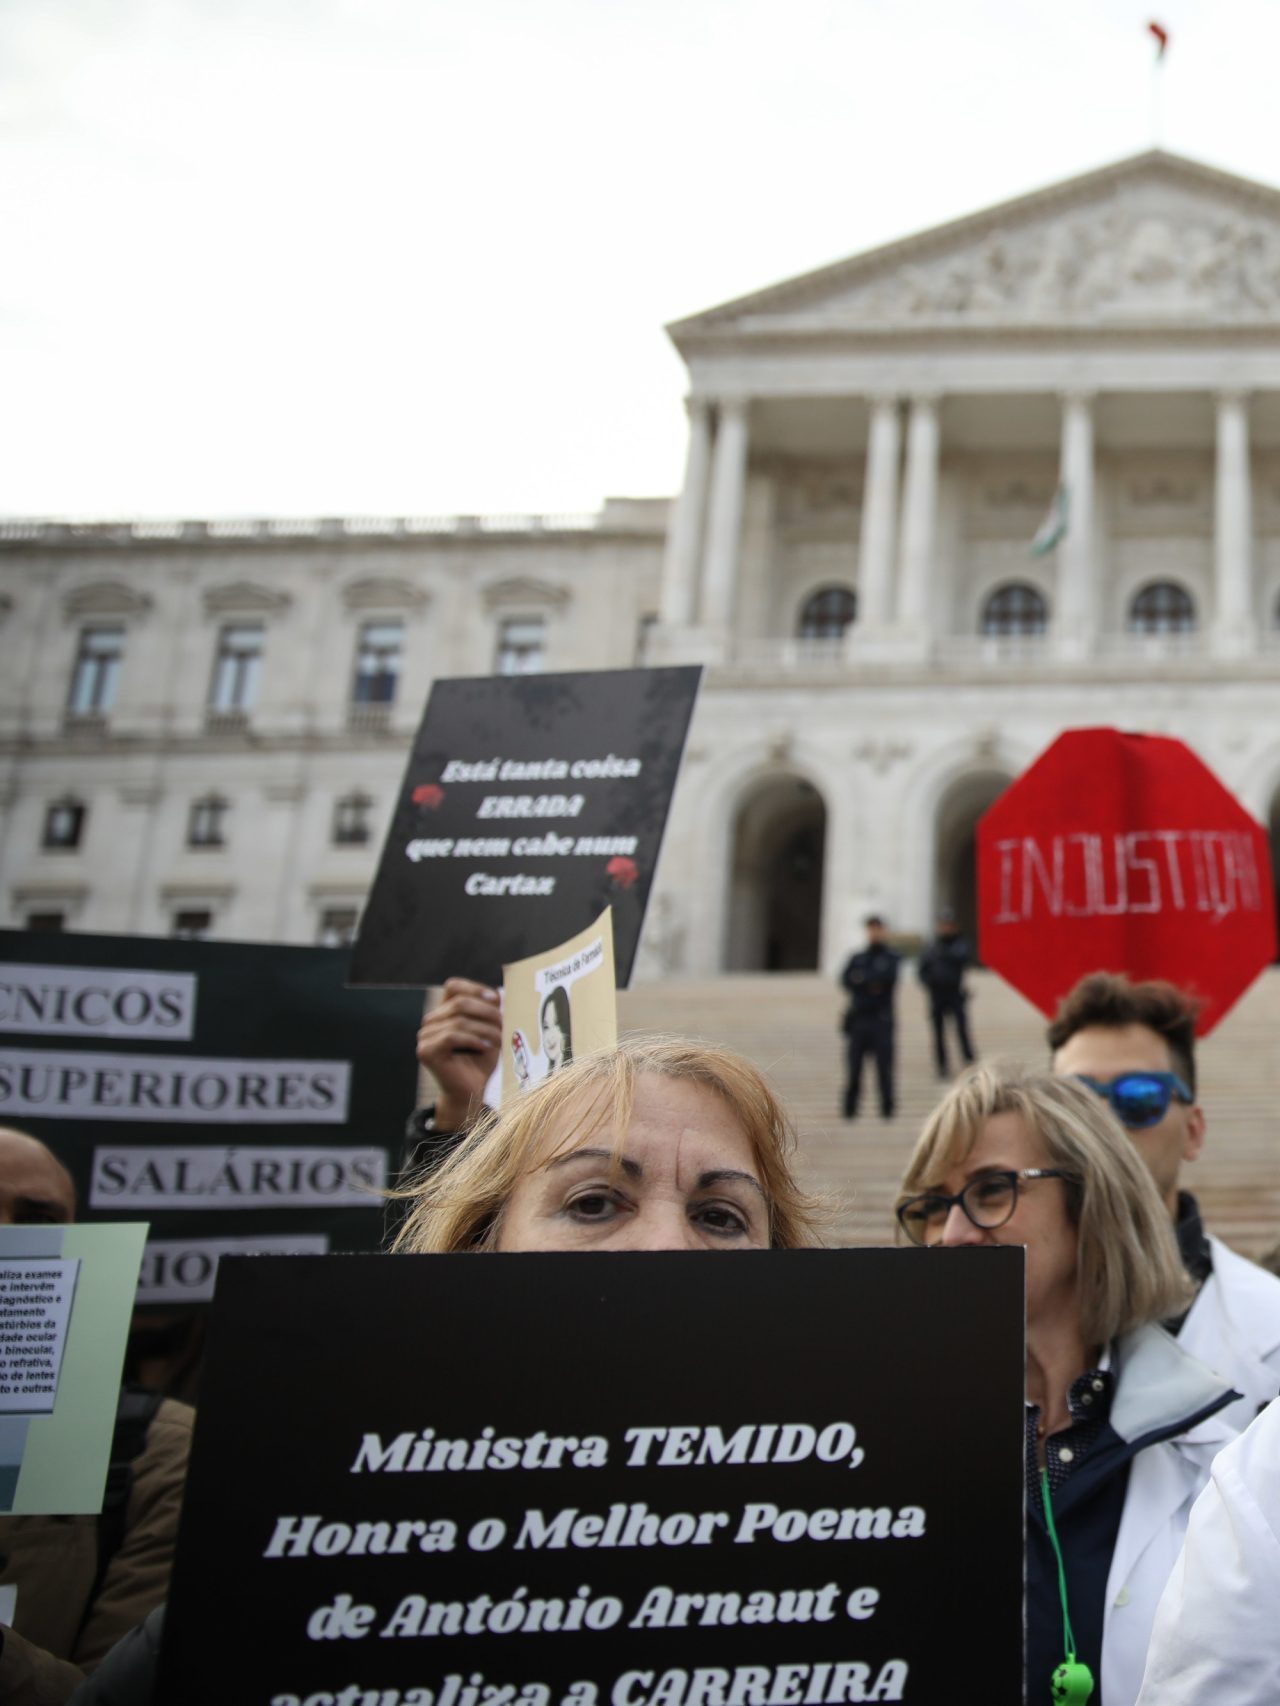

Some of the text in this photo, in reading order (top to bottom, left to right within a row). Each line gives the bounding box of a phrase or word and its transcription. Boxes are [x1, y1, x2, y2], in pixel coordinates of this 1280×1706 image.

[441, 754, 642, 783] Está tanta coisa
[476, 794, 586, 819] ERRADA
[406, 831, 638, 861] que nem cabe num
[100, 1147, 376, 1197] SALÁRIOS
[351, 1422, 864, 1473] Ministra TEMIDO,
[264, 1503, 925, 1557] Honra o Melhor Poema
[307, 1583, 879, 1640] de António Arnaut e
[612, 1659, 908, 1706] CARREIRA
